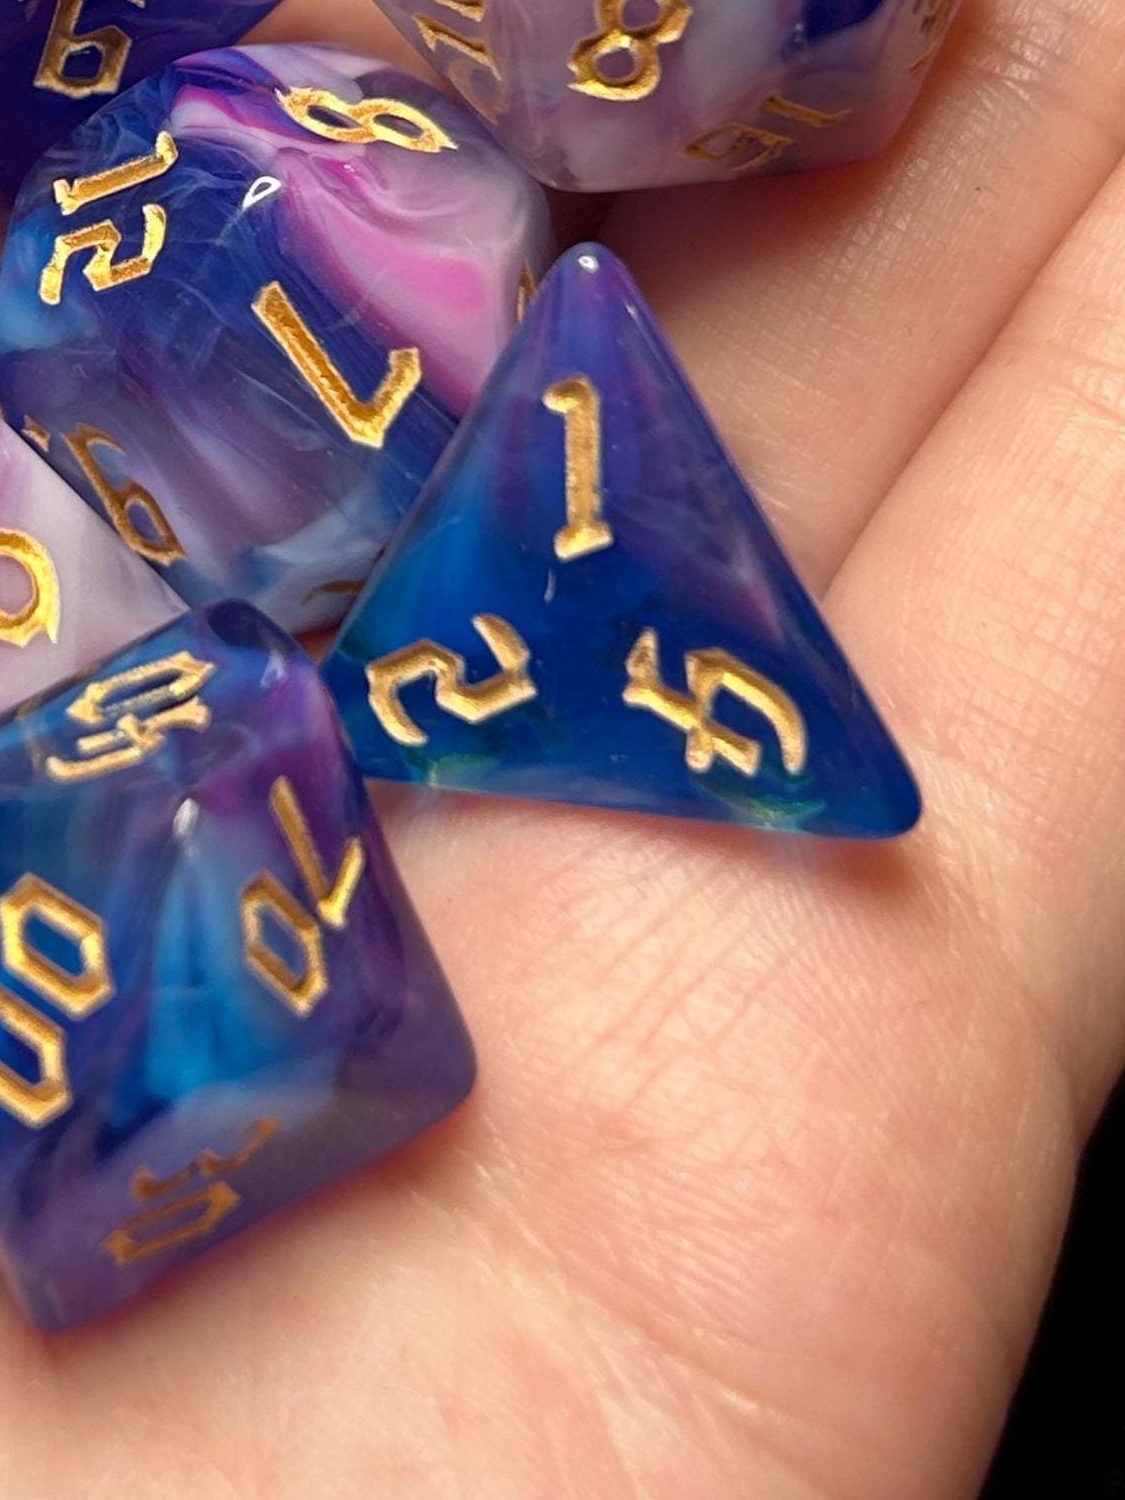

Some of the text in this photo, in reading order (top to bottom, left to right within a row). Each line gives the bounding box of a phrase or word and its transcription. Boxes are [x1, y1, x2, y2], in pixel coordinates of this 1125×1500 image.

[275, 86, 458, 153] 8
[39, 130, 178, 305] 12
[251, 281, 421, 448] 7
[543, 374, 613, 561] 1
[366, 613, 536, 746] 2
[623, 627, 807, 777] 4
[241, 775, 365, 1018] 70
